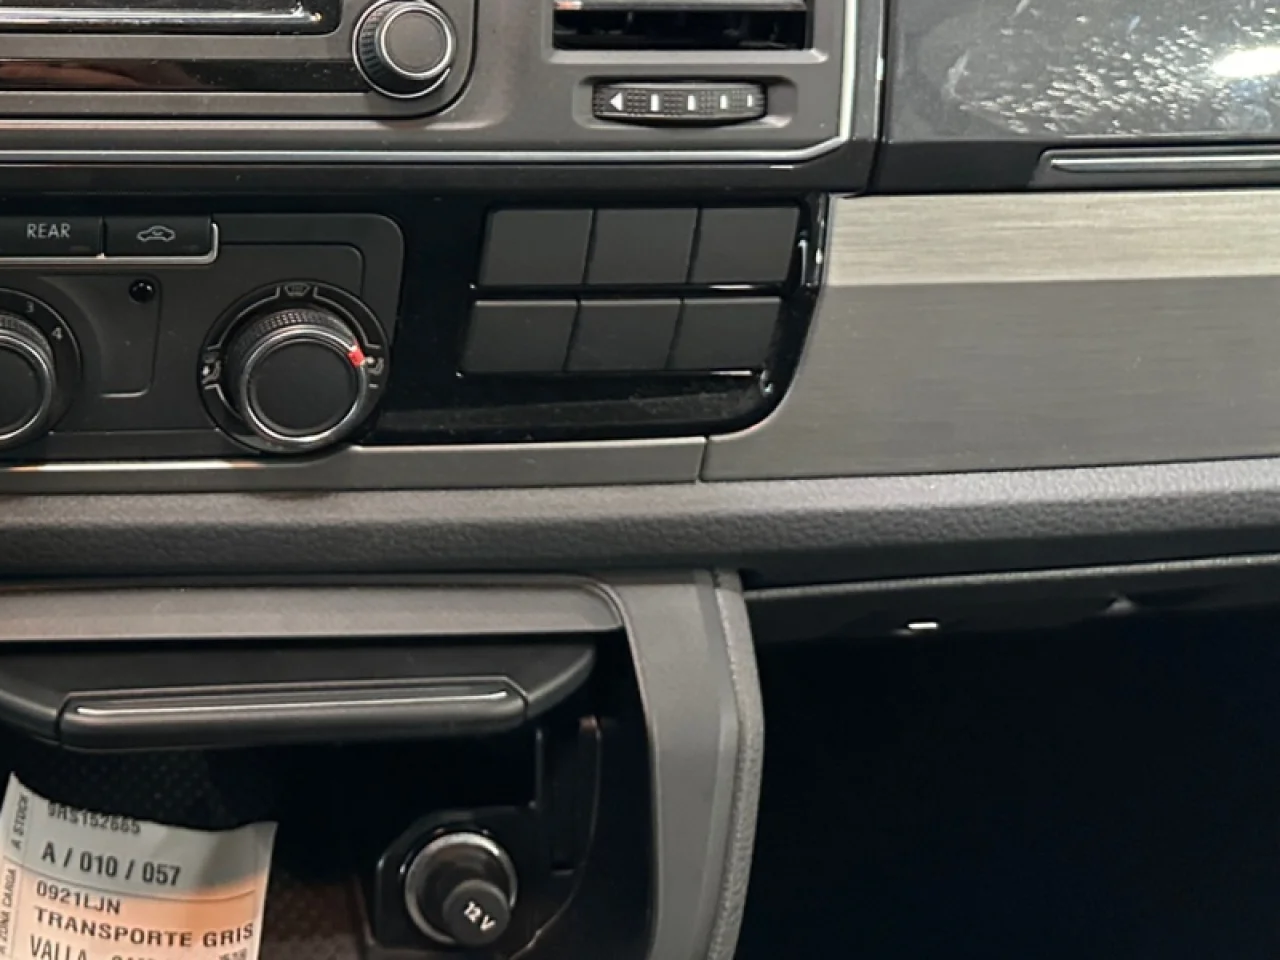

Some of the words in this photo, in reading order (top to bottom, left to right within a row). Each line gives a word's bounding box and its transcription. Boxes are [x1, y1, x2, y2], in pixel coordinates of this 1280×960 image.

[26, 223, 71, 239] REAR
[41, 841, 56, 864] A
[79, 853, 117, 879] 010
[141, 861, 182, 887] 057
[36, 879, 122, 916] 0921LJN
[34, 905, 193, 948] TRANSPORTE
[202, 923, 254, 948] GRIS
